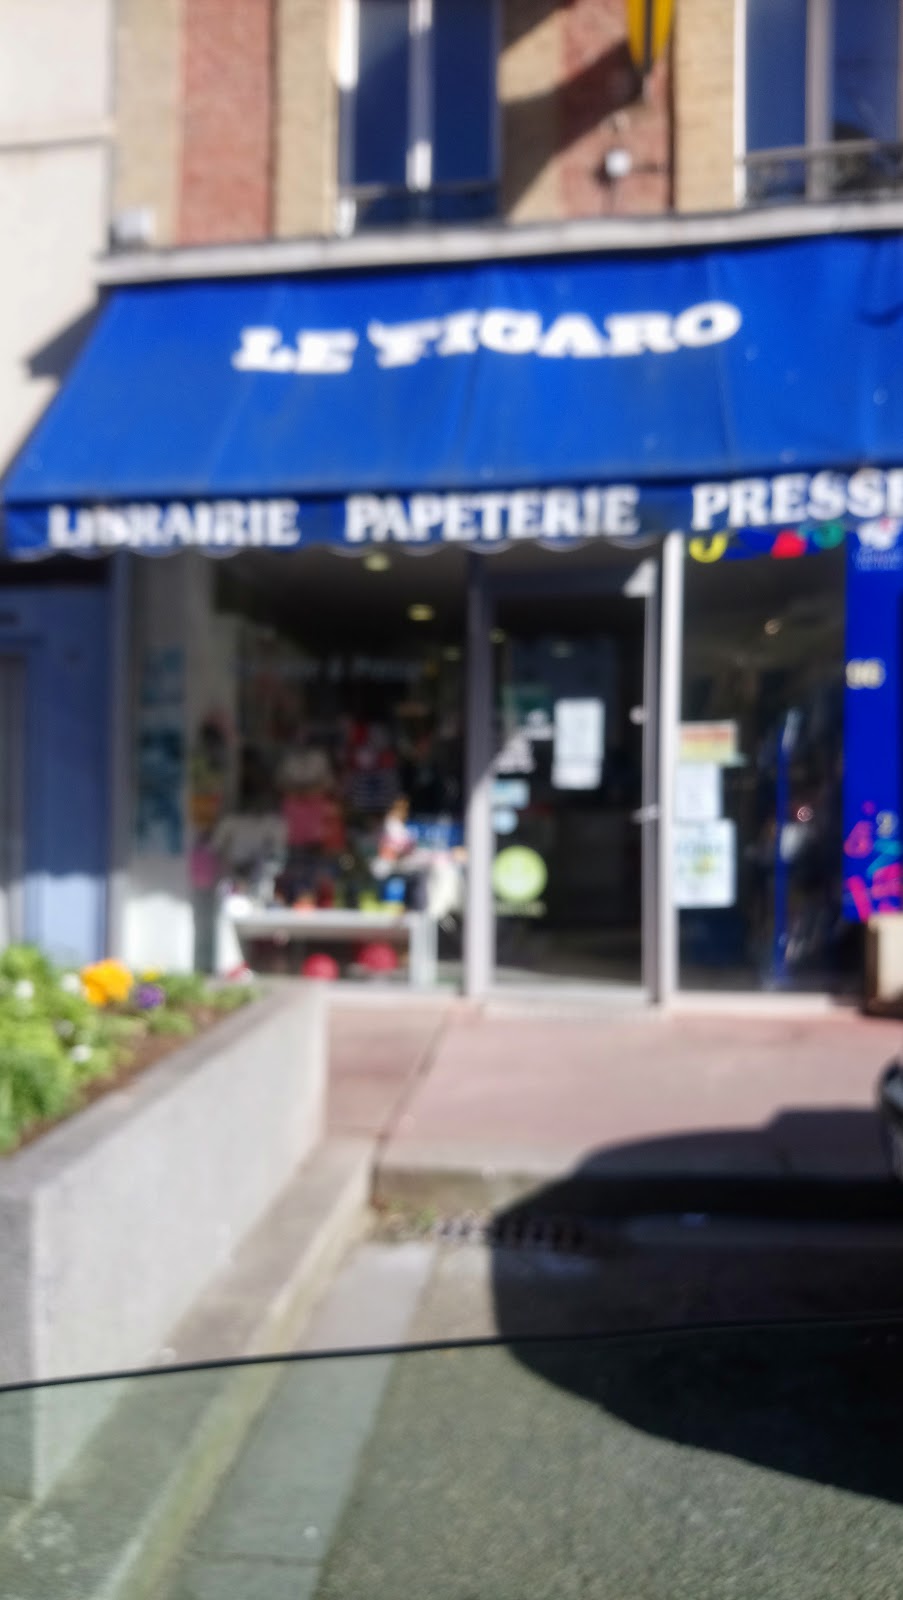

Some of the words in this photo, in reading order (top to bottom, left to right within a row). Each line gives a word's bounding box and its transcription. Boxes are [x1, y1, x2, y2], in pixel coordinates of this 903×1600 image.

[233, 326, 358, 374] LE
[367, 301, 742, 368] FIGARO
[49, 499, 300, 548] LIBRAIRIE
[345, 487, 639, 542] PAPETERIE
